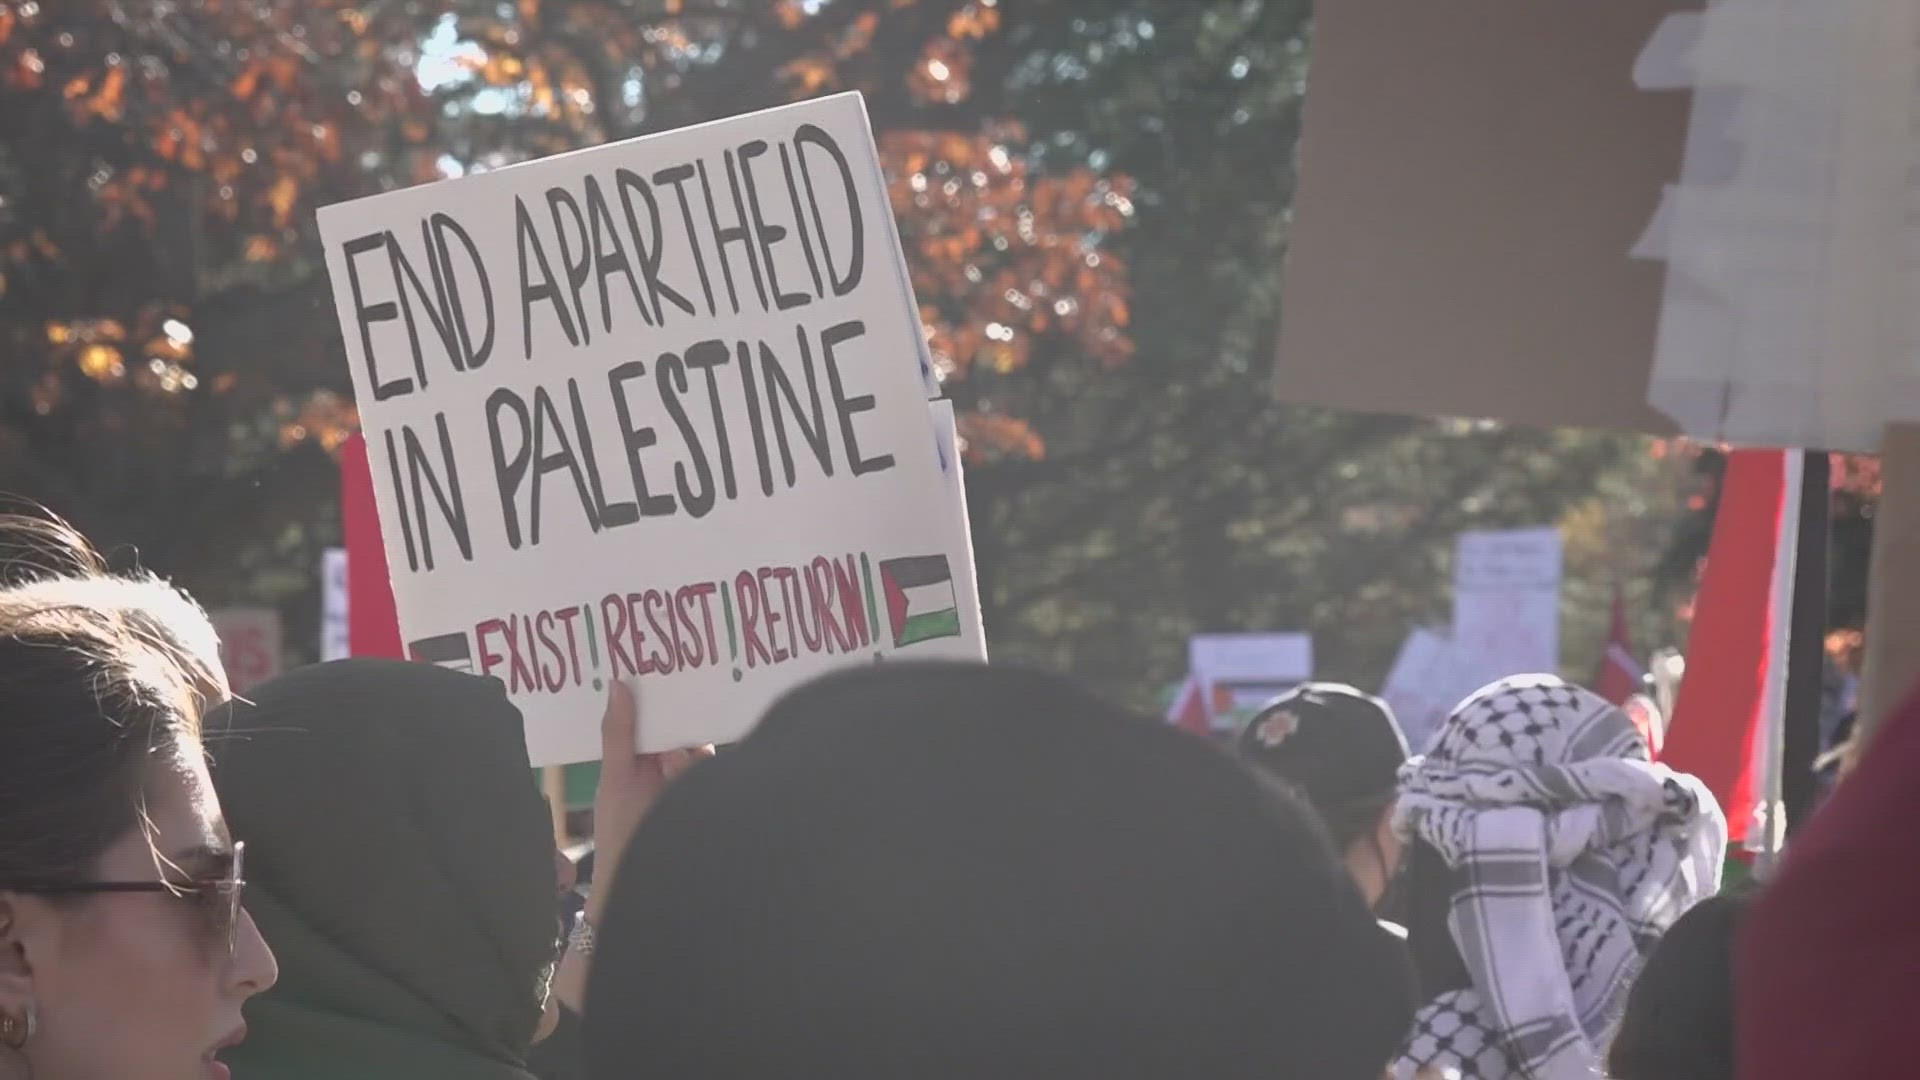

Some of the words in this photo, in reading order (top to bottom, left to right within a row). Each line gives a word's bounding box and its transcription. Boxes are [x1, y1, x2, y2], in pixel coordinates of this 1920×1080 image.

[342, 212, 495, 401] END
[515, 124, 864, 360] APARTHEID
[384, 412, 473, 572] IN
[485, 320, 896, 550] PALESTINE
[600, 581, 743, 682] RESIST!
